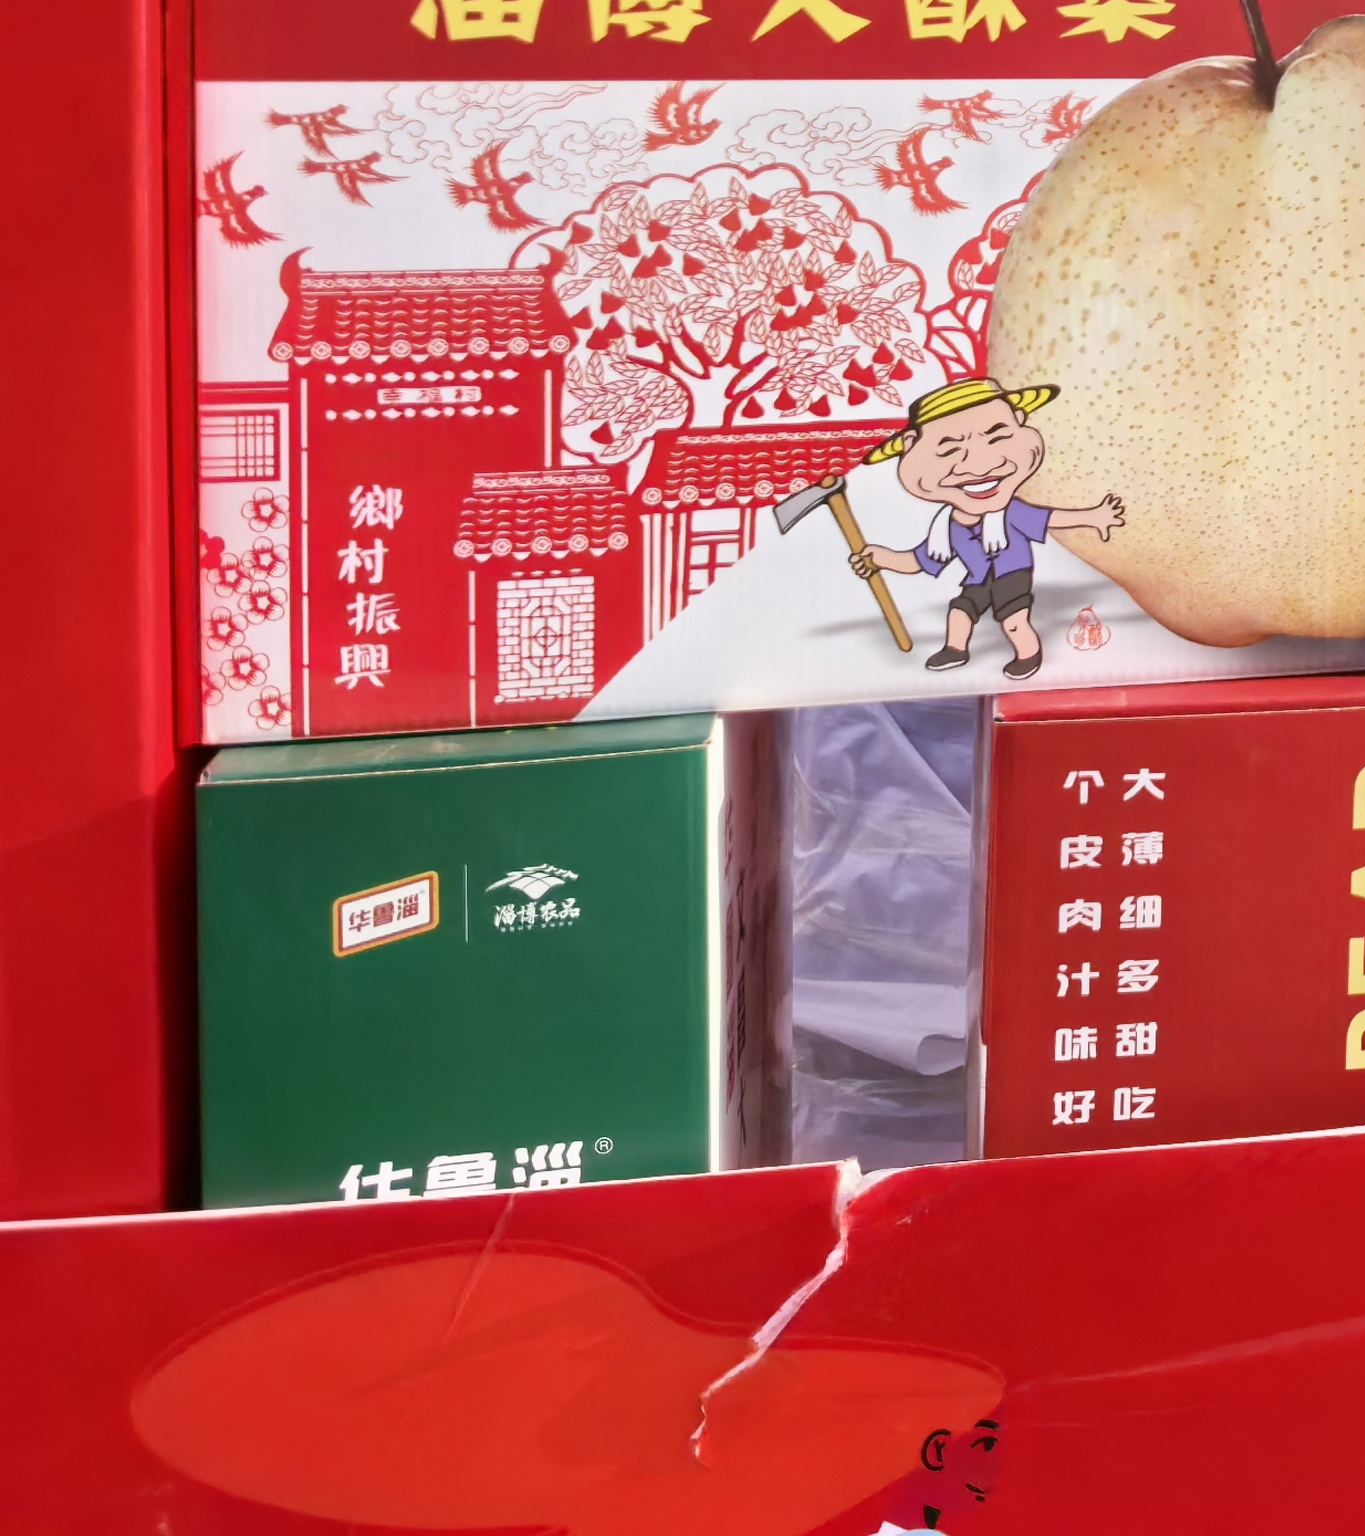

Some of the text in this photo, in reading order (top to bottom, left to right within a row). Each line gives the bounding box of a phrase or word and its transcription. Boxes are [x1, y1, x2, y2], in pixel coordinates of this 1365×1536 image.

[334, 484, 404, 690] 鄉村振興
[1062, 767, 1166, 805] 个大
[1059, 831, 1164, 869] 皮薄
[494, 897, 581, 928] 淄博农品
[1057, 895, 1162, 934] 肉细
[1056, 959, 1160, 997] 汁多
[1054, 1021, 1158, 1061] 味甜
[1052, 1086, 1157, 1125] 好吃
